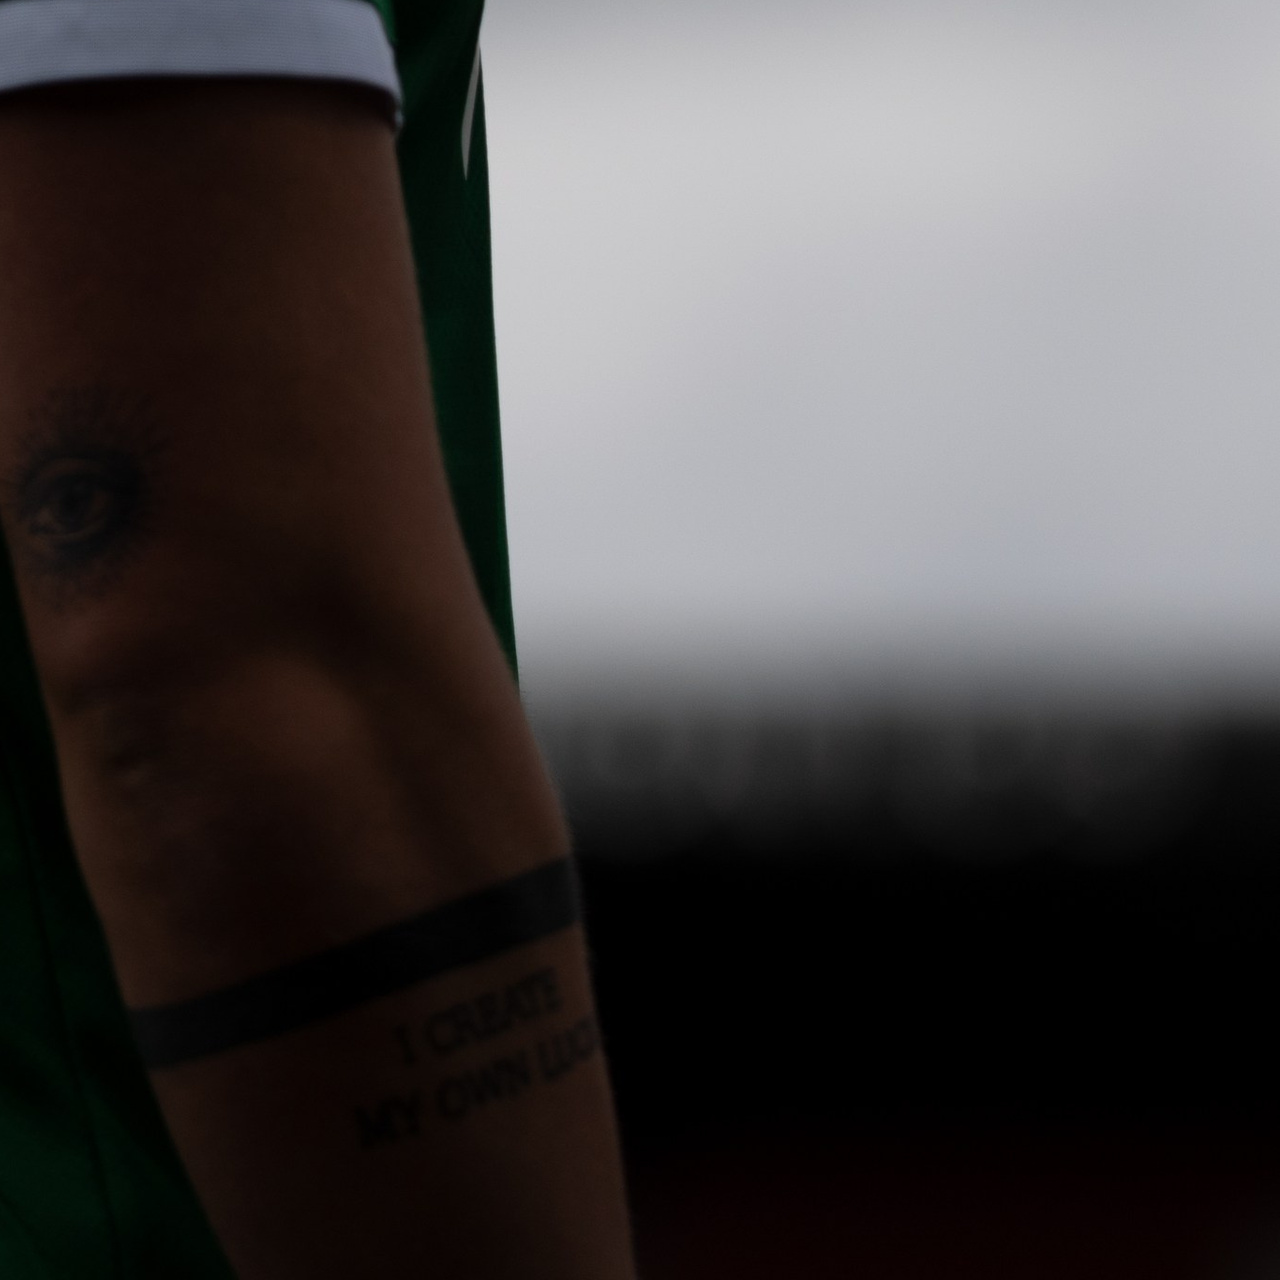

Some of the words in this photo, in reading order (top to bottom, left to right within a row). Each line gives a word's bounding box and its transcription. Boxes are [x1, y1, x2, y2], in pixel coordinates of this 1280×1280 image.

[423, 966, 564, 1055] CREATE
[354, 1087, 421, 1152] MY
[435, 1049, 531, 1122] OWN
[535, 1014, 604, 1084] LUC
